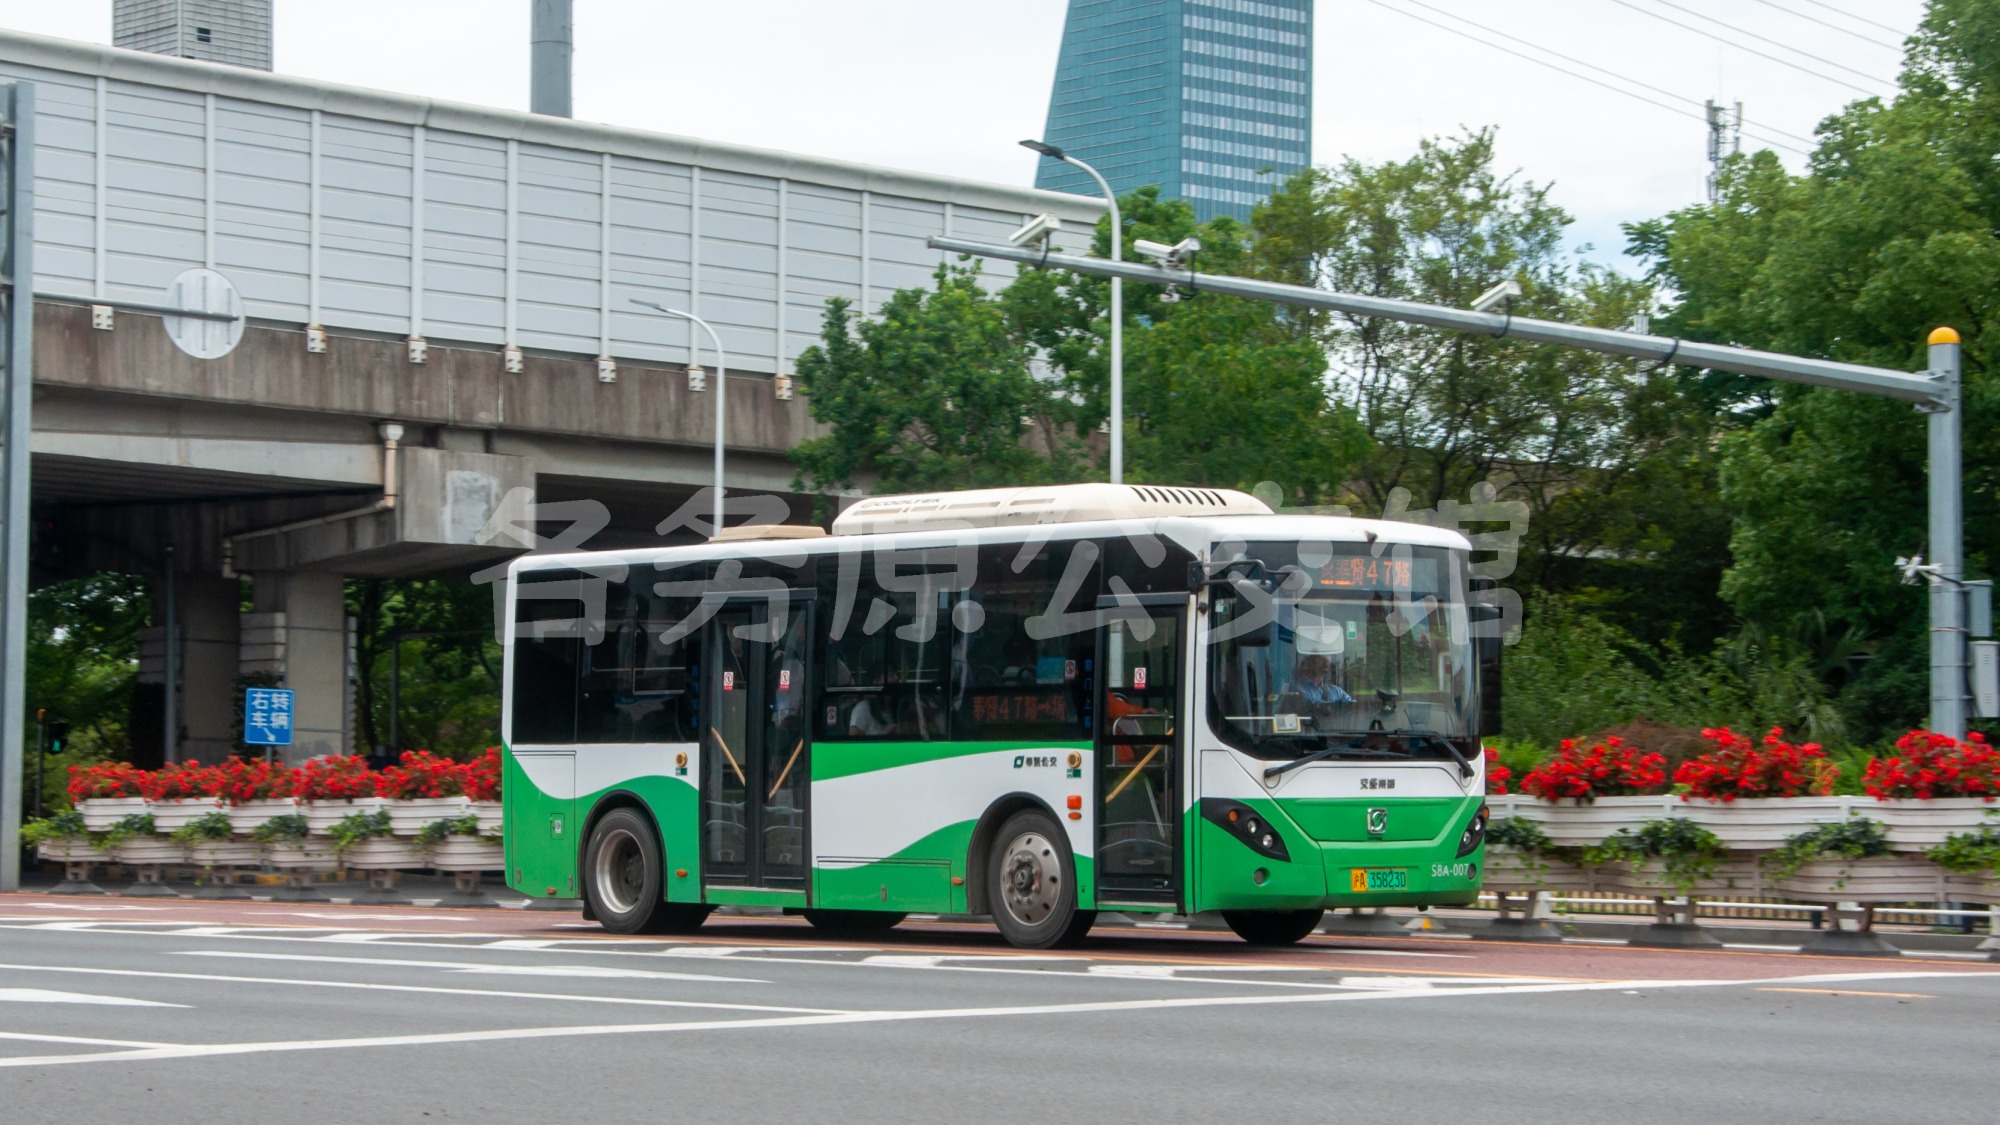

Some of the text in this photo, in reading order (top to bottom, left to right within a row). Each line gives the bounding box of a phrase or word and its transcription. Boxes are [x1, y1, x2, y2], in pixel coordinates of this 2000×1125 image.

[251, 692, 290, 710] 右转
[250, 711, 289, 729] 车辆
[1431, 863, 1469, 878] S8A-007
